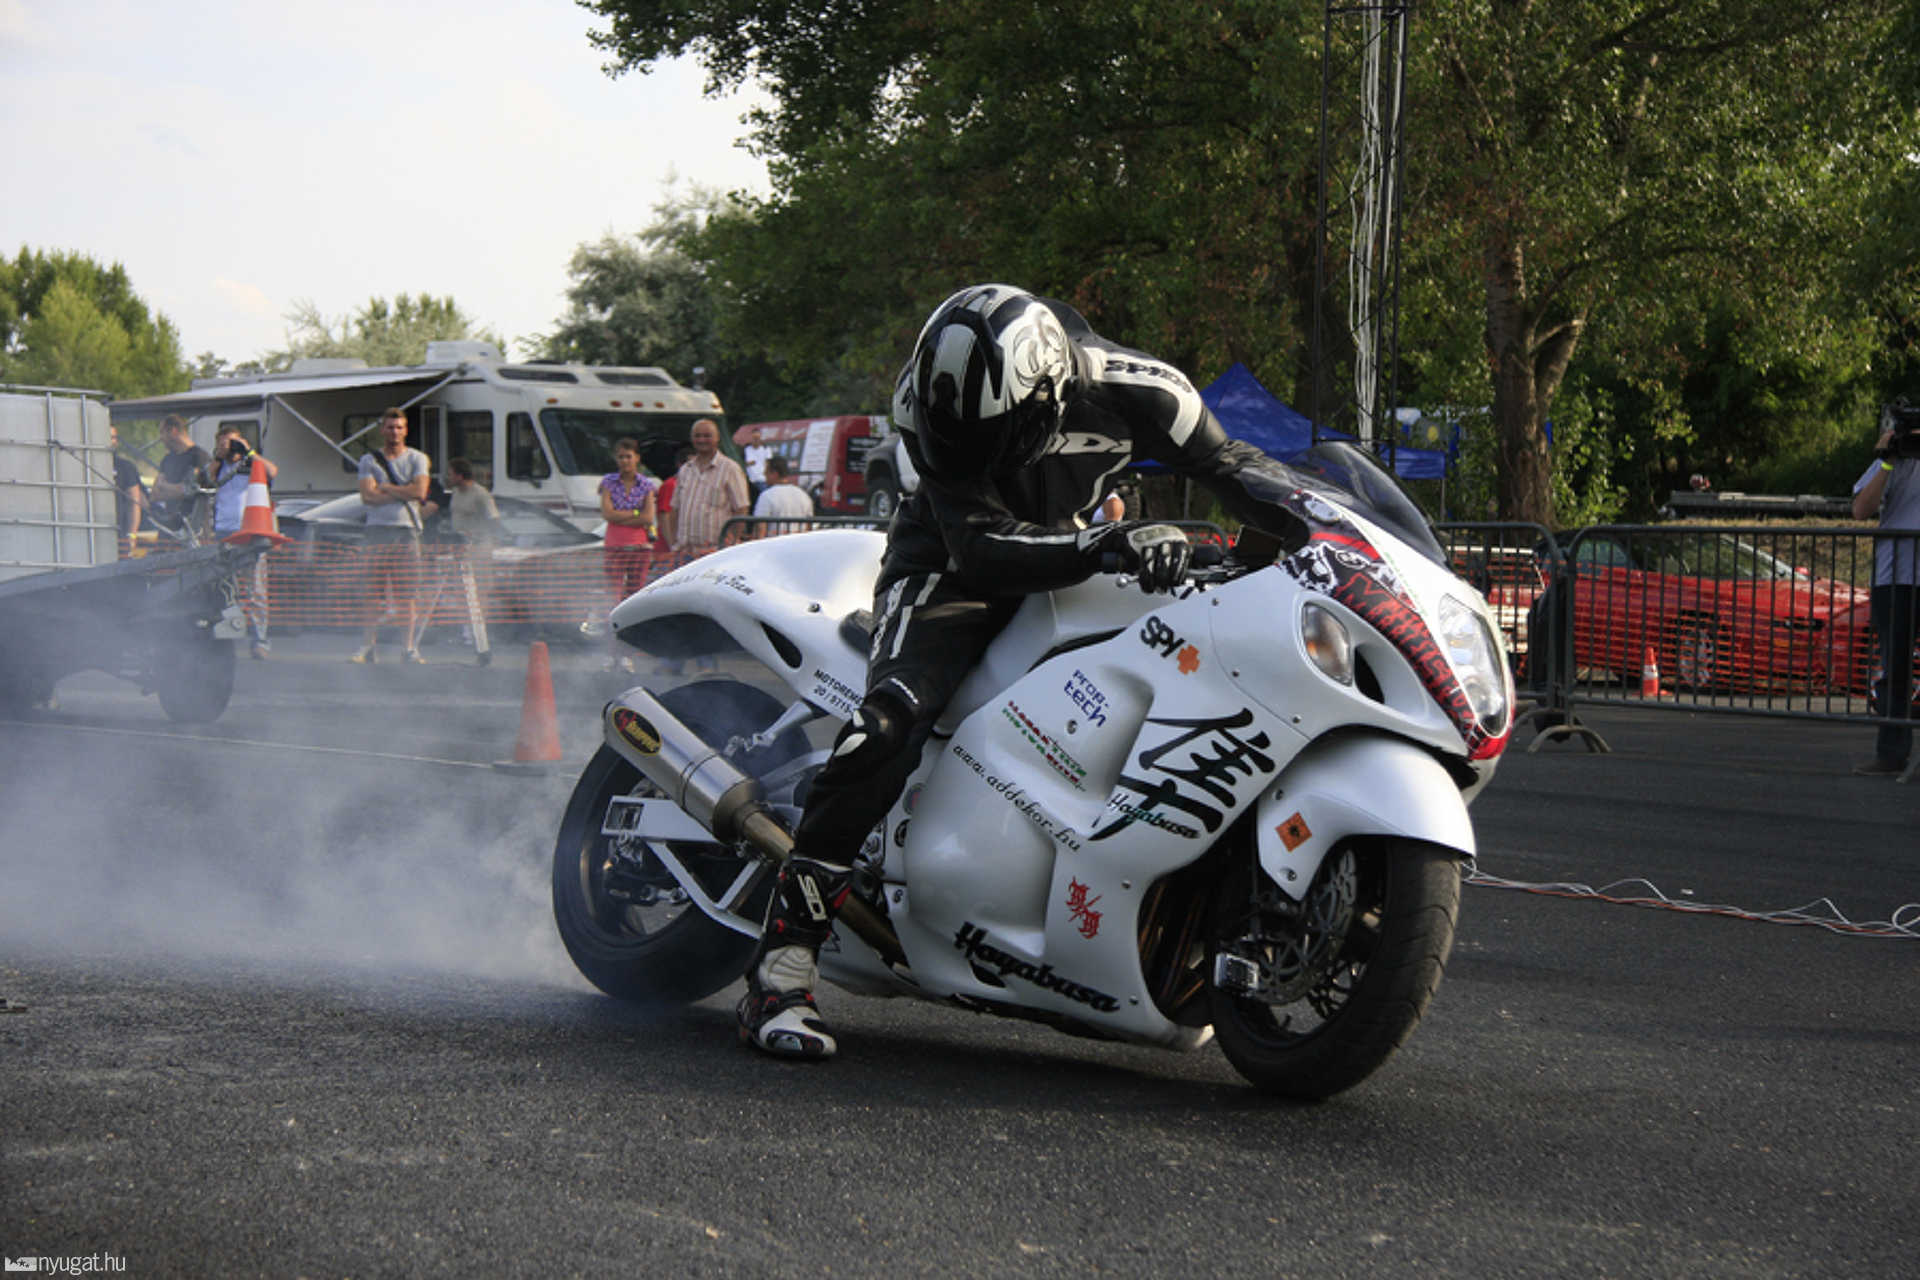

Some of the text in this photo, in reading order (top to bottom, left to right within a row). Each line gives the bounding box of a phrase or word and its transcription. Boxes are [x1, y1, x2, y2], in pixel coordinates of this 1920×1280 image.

[1064, 680, 1106, 727] tech
[953, 745, 1081, 852] www.addekor.hu
[1107, 792, 1200, 839] Hayabusa
[954, 921, 1120, 1012] Hayabusa
